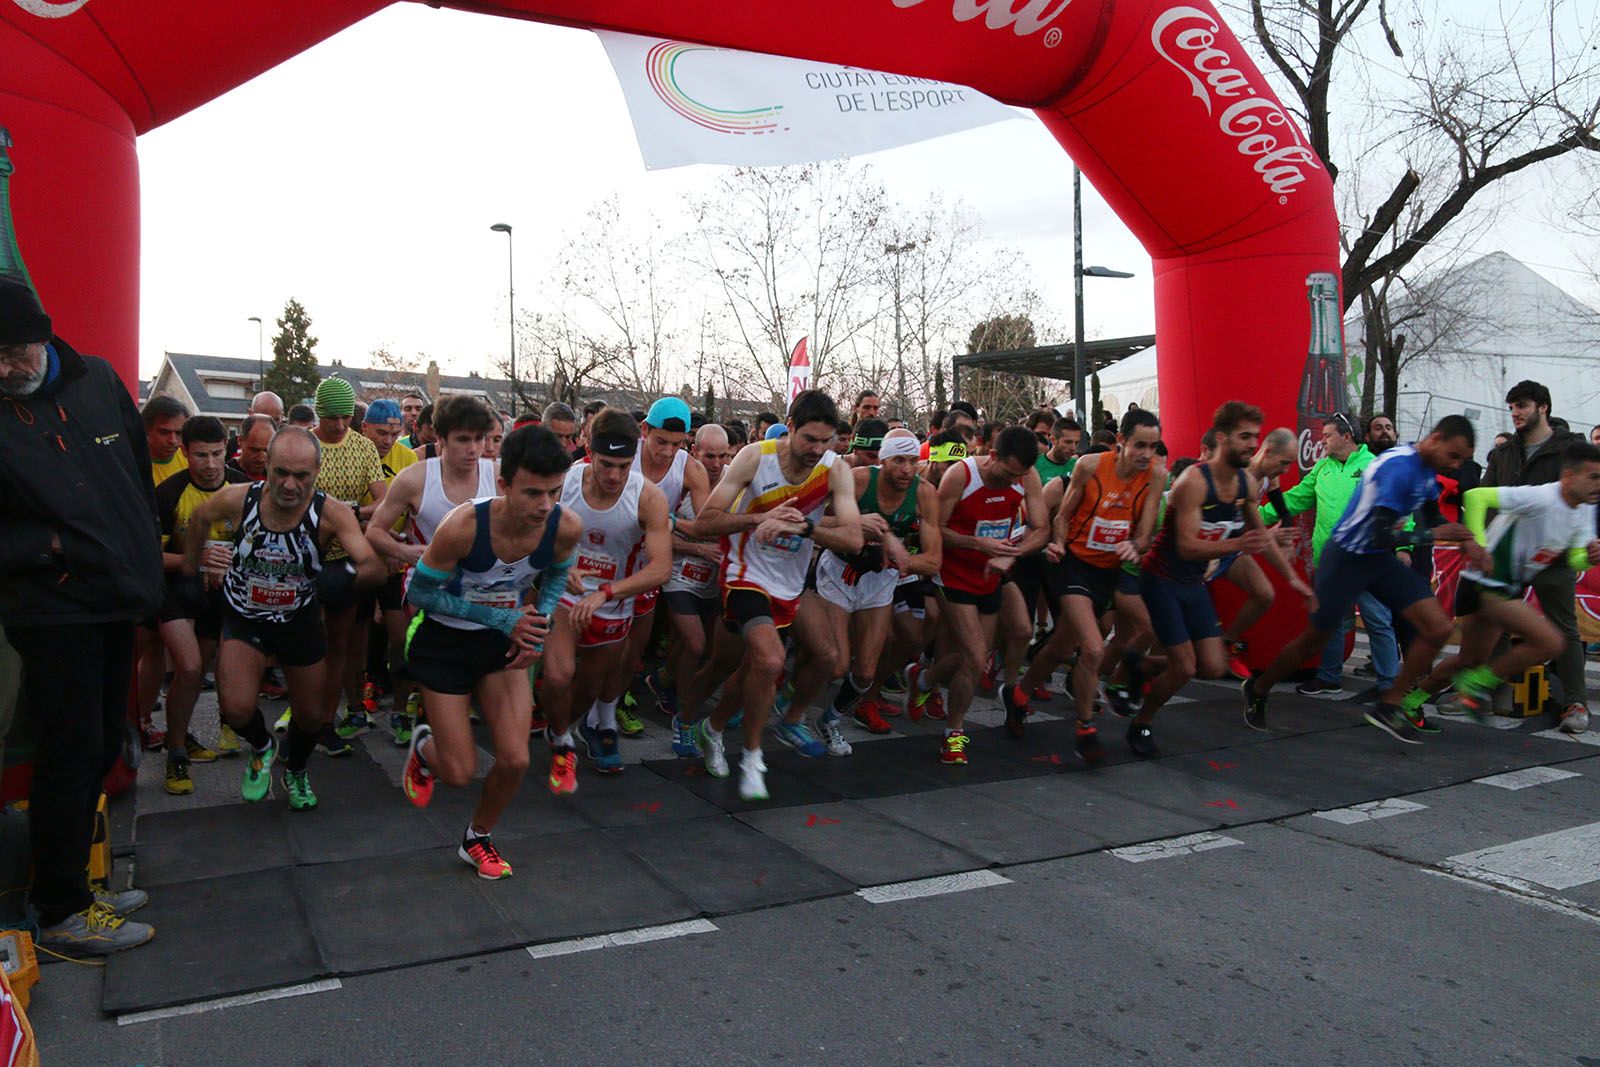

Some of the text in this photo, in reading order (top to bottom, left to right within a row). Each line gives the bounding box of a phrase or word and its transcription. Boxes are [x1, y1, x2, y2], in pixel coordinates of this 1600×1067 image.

[805, 72, 877, 89] CIUTAT
[836, 90, 966, 112] DE L'ESPORT
[1151, 6, 1320, 194] Coca-Cola
[257, 587, 291, 598] PEDRO
